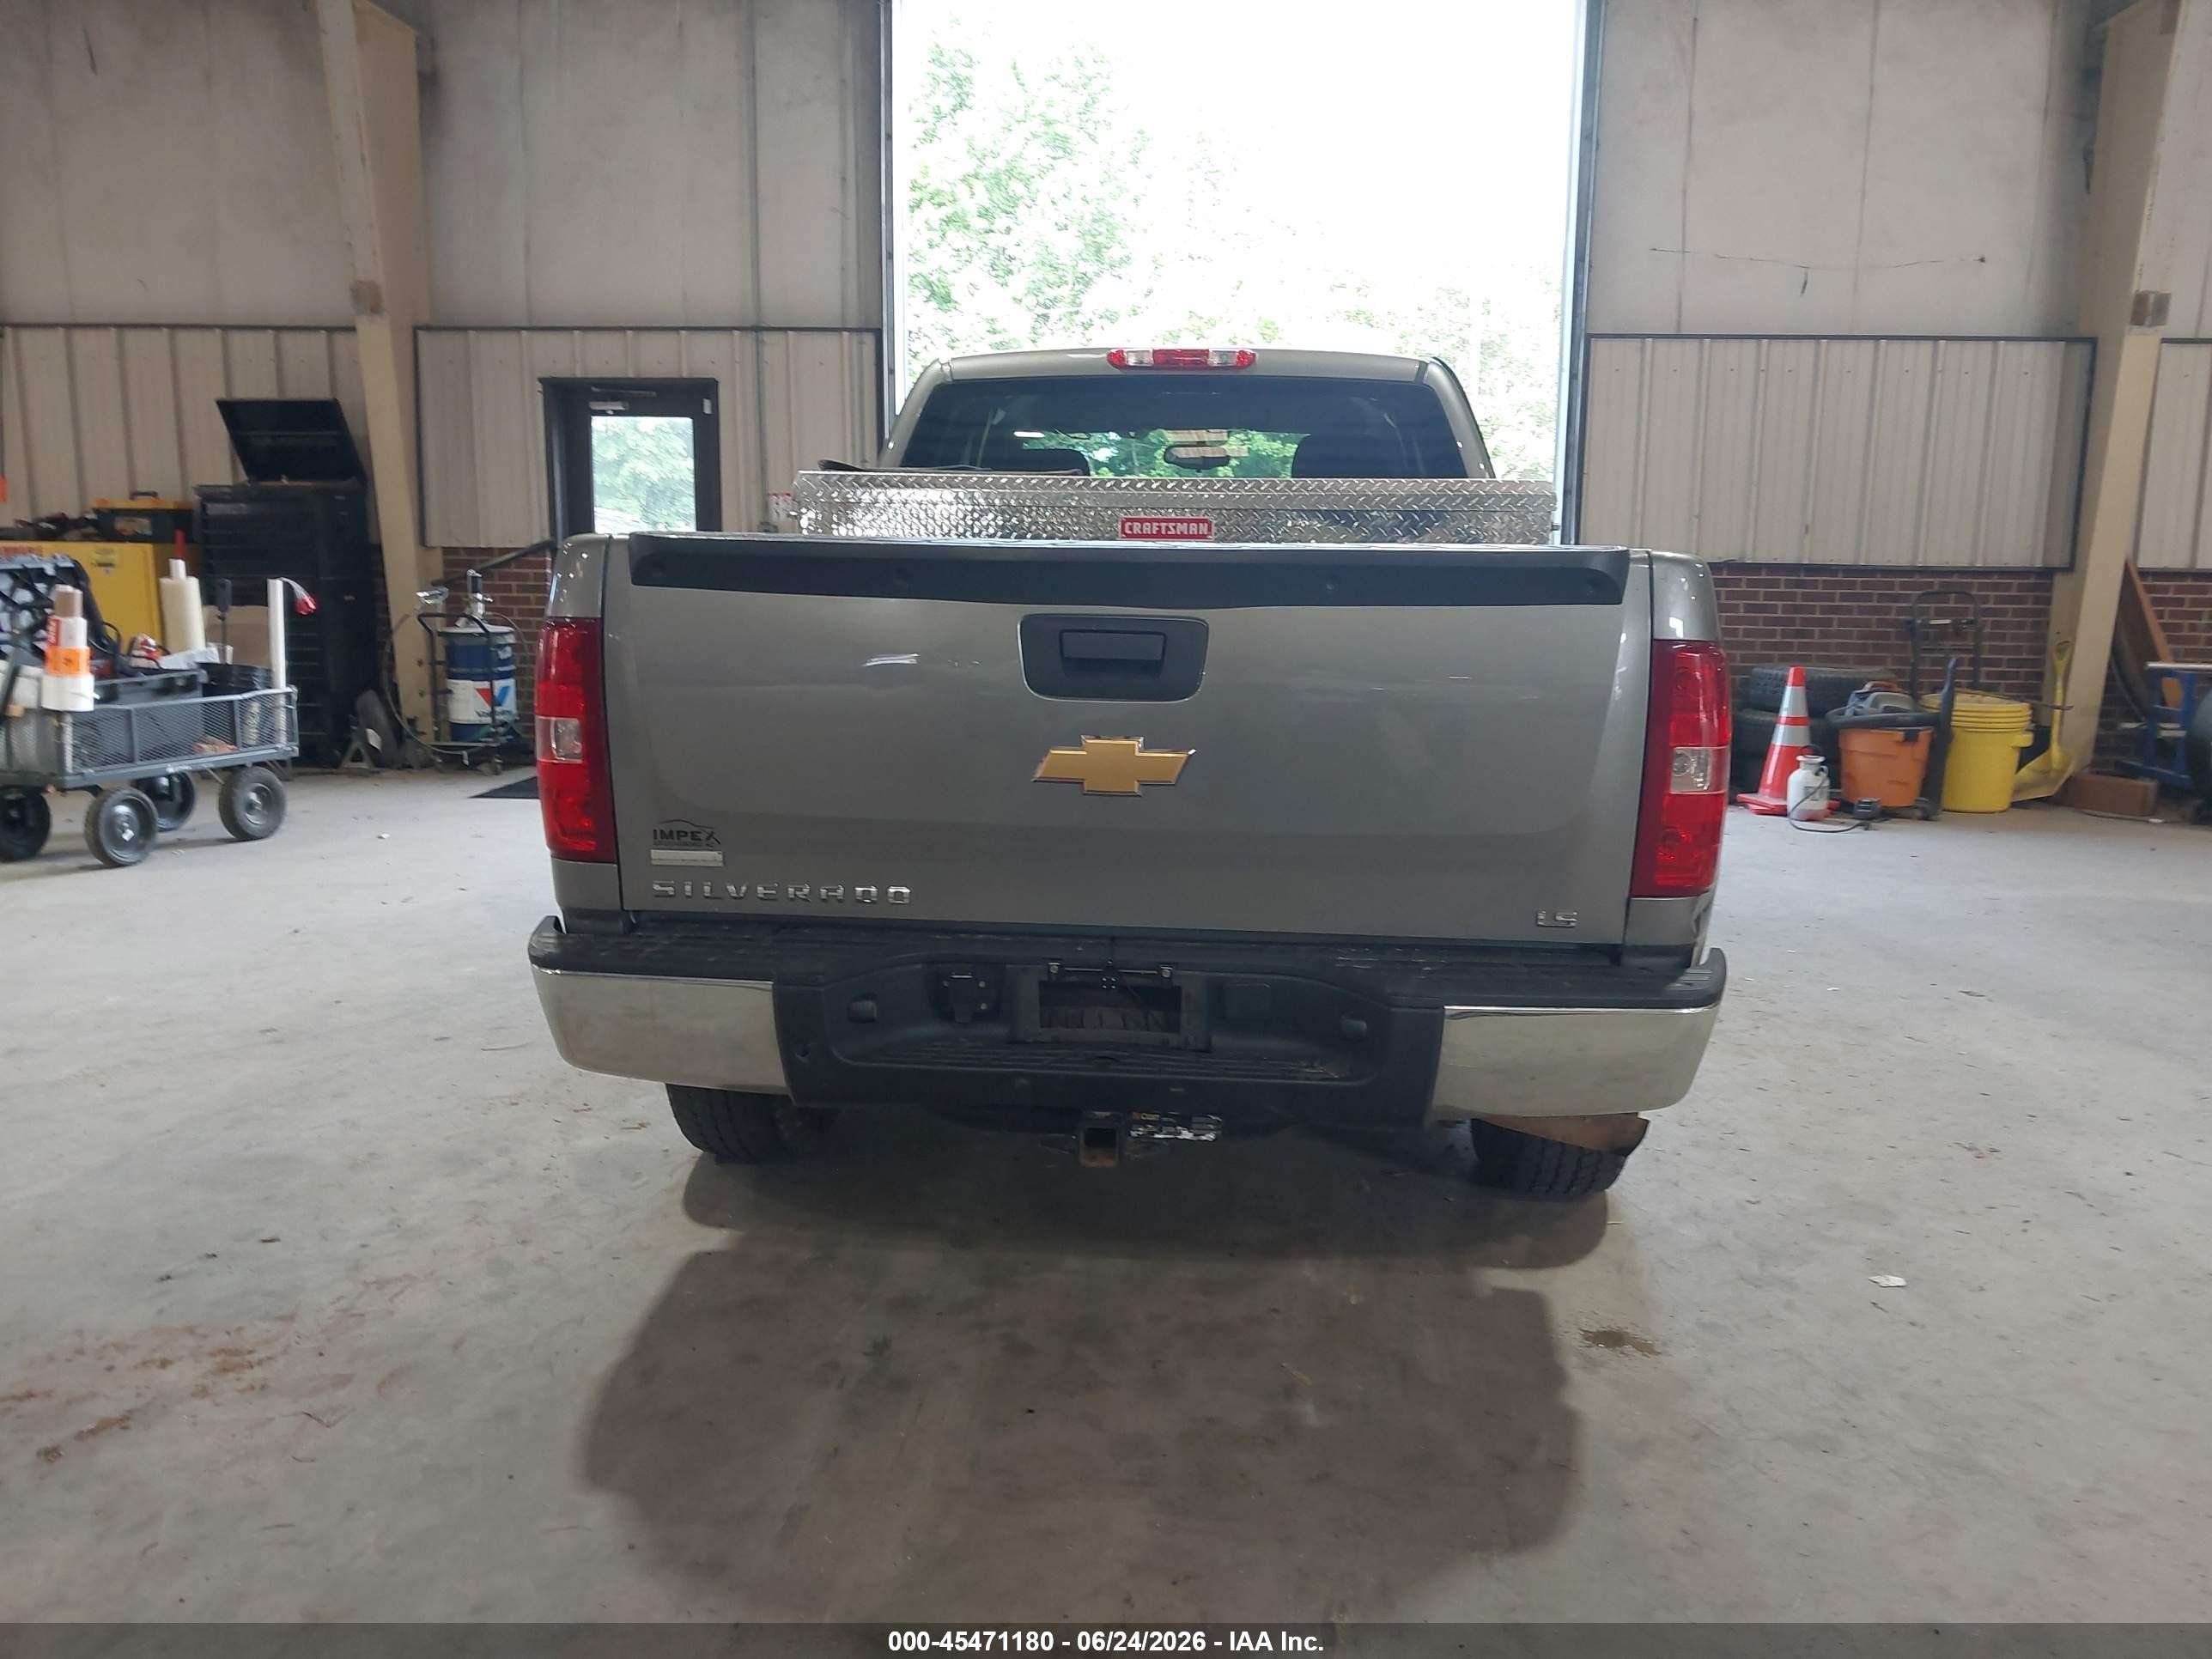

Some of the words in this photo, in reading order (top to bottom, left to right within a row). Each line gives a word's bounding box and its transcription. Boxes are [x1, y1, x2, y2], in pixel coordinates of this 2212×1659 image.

[1124, 521, 1209, 535] CRAFTSMAN
[653, 829, 721, 845] IMPEX
[651, 879, 912, 904] SILVERADO
